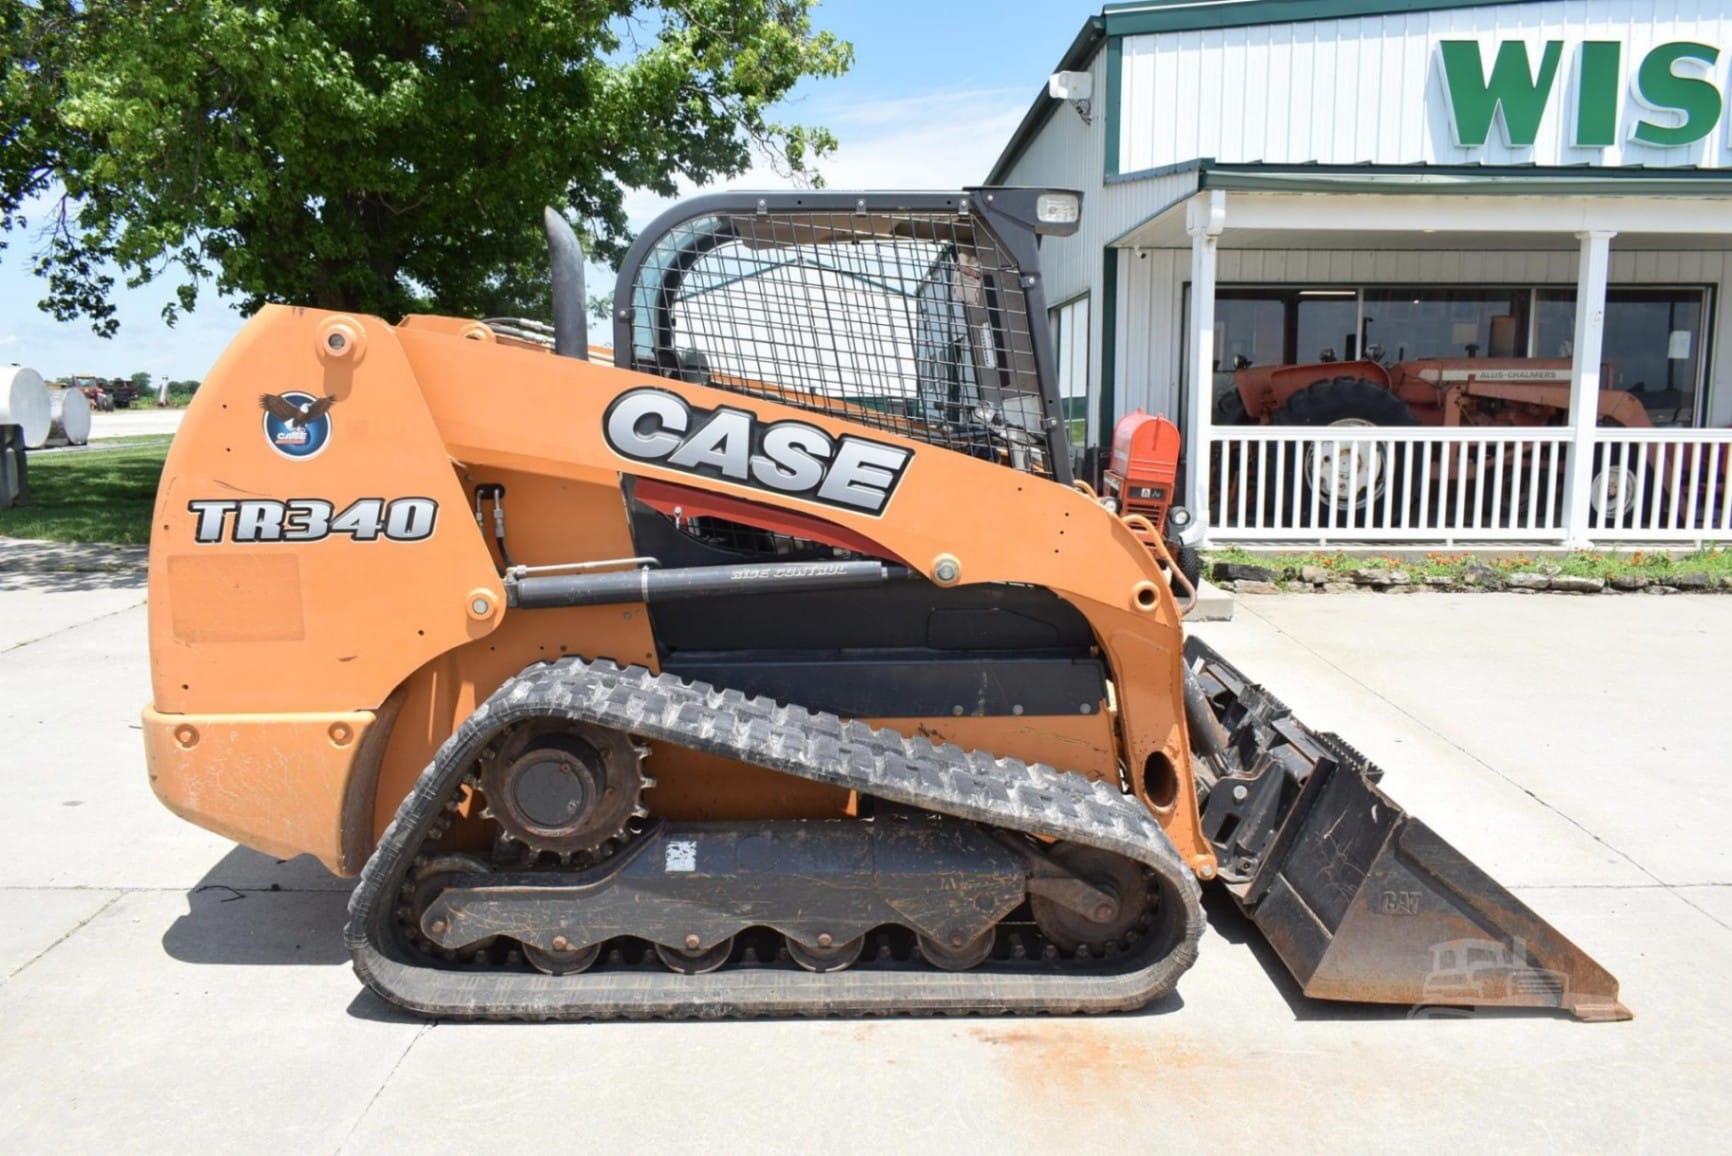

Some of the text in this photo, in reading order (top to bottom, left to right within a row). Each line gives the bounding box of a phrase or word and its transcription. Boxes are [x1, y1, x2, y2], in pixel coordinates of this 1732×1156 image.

[605, 388, 912, 514] CASE
[188, 497, 438, 543] TR340
[774, 564, 848, 578] CONTROL
